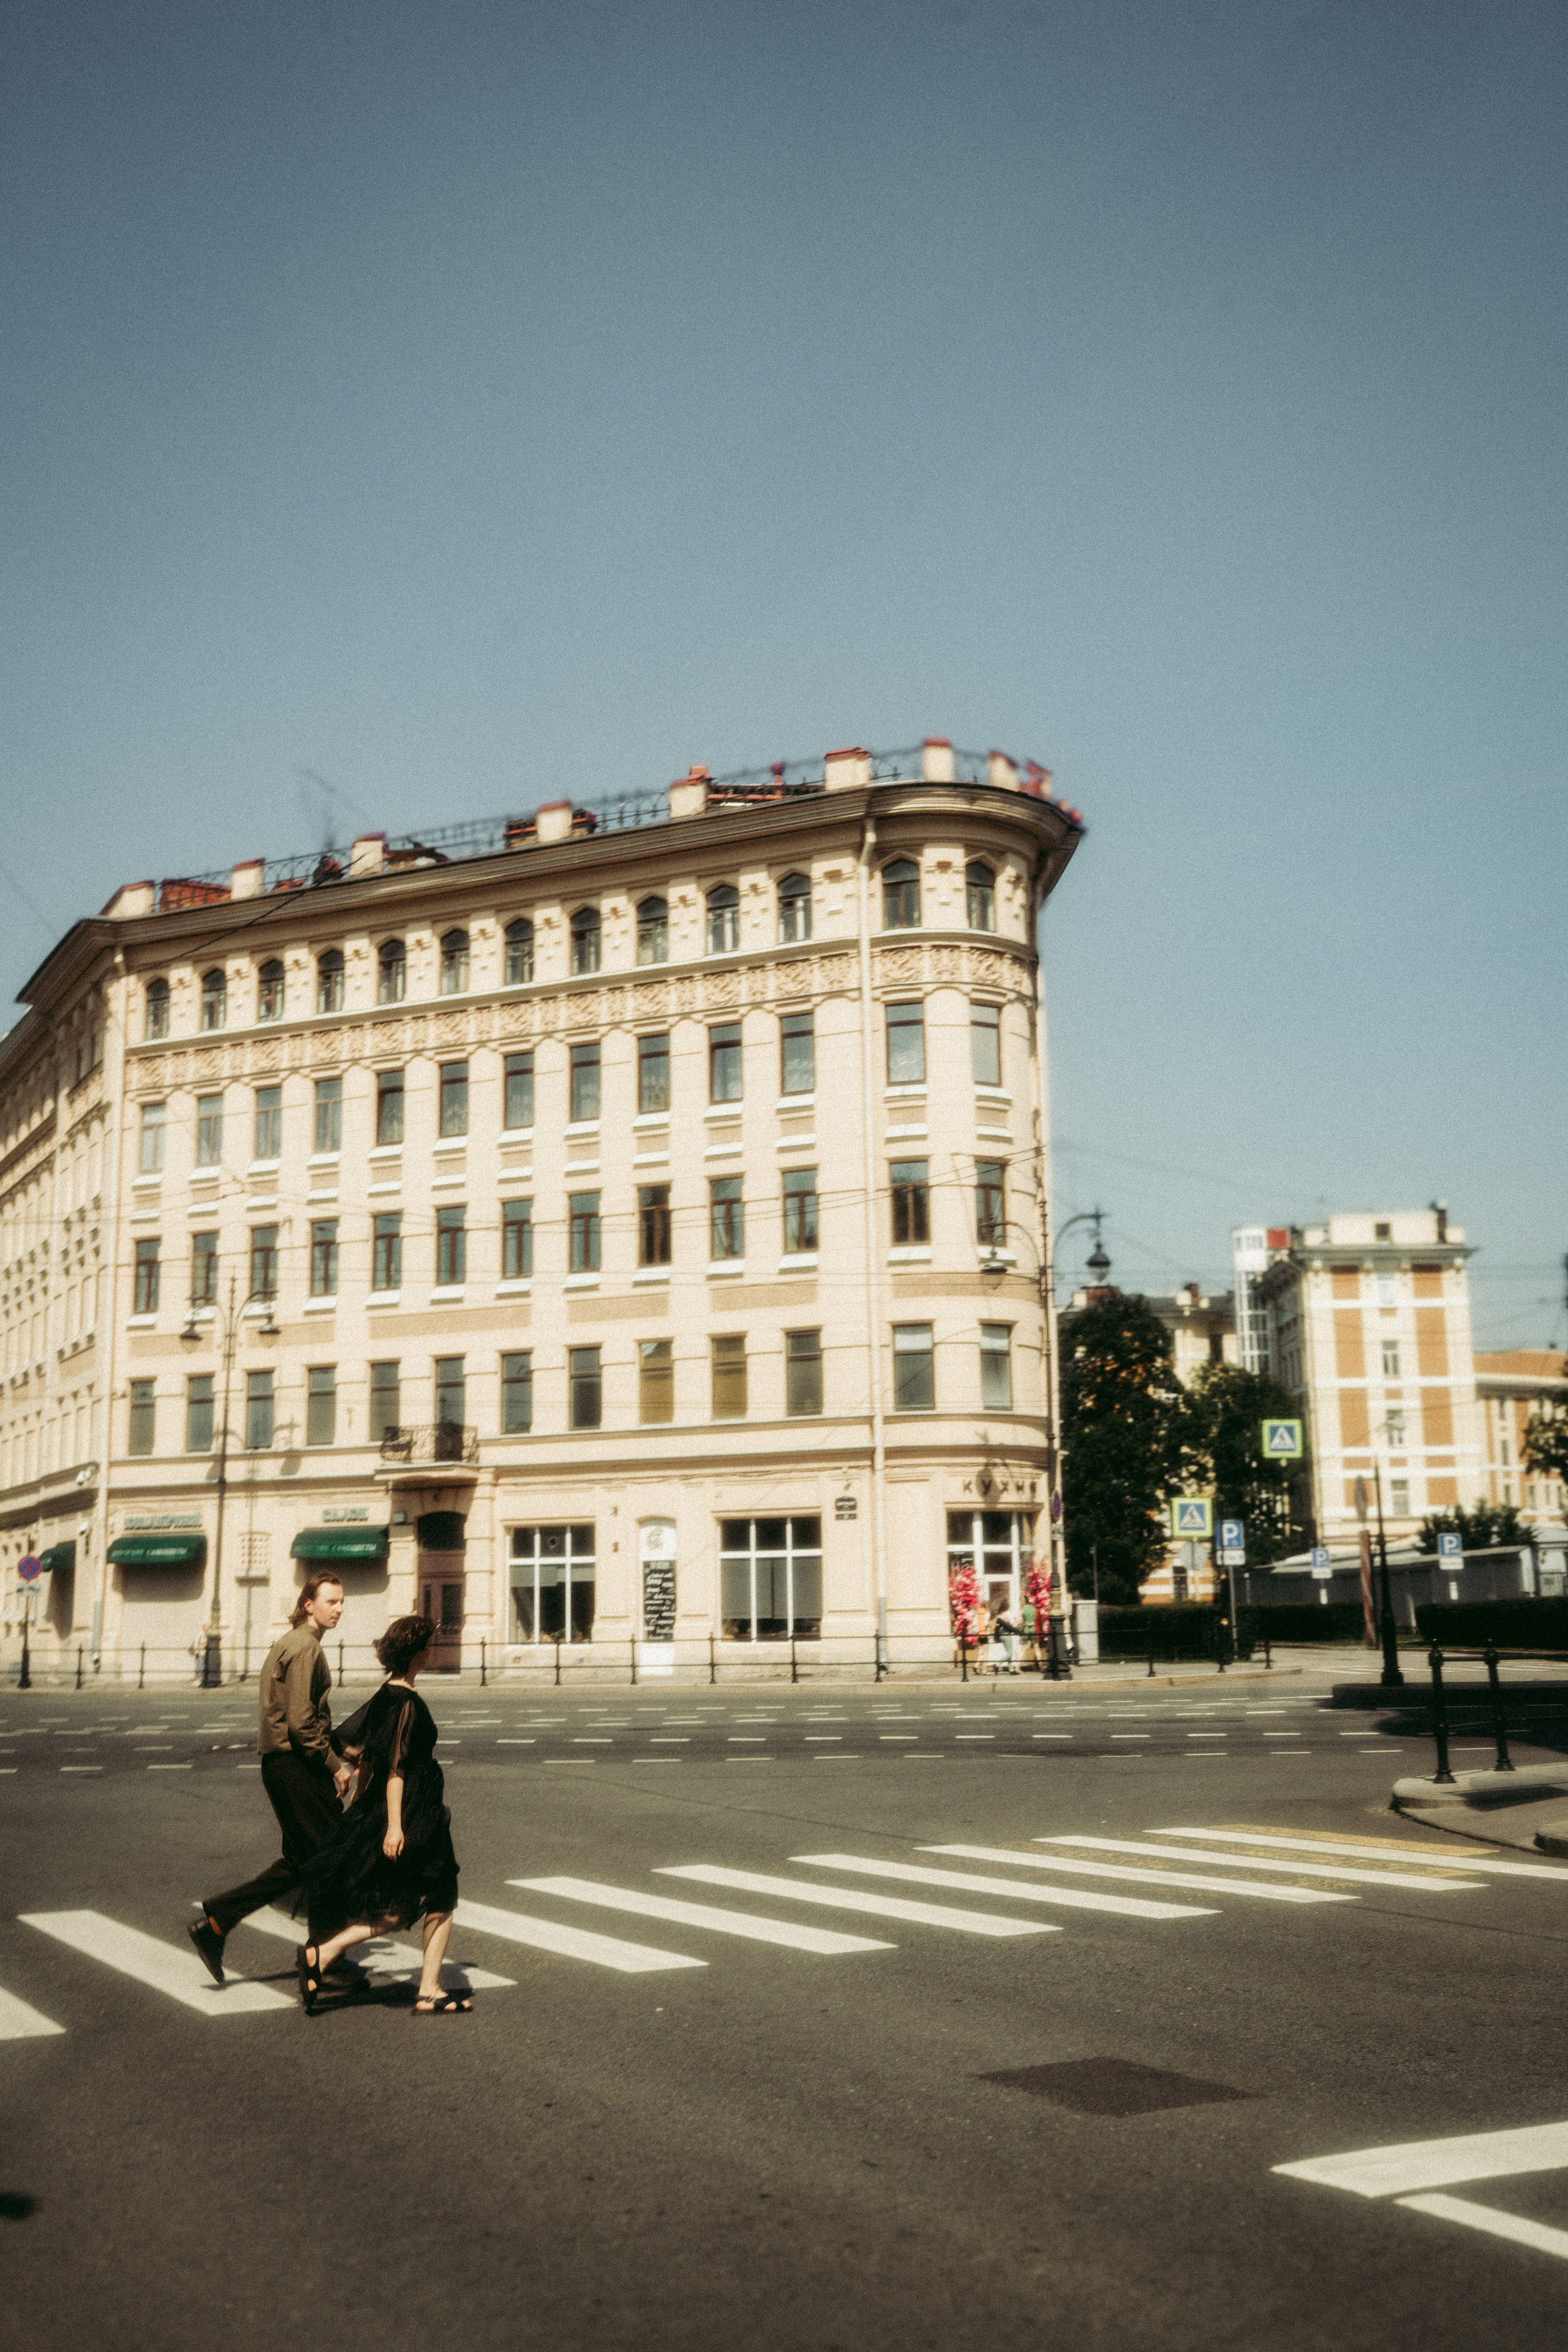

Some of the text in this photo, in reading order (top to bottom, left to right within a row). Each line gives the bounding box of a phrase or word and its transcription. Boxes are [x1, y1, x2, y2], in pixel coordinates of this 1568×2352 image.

[1222, 1523, 1238, 1546] P
[1444, 1536, 1457, 1553] P
[1316, 1550, 1327, 1566] P
